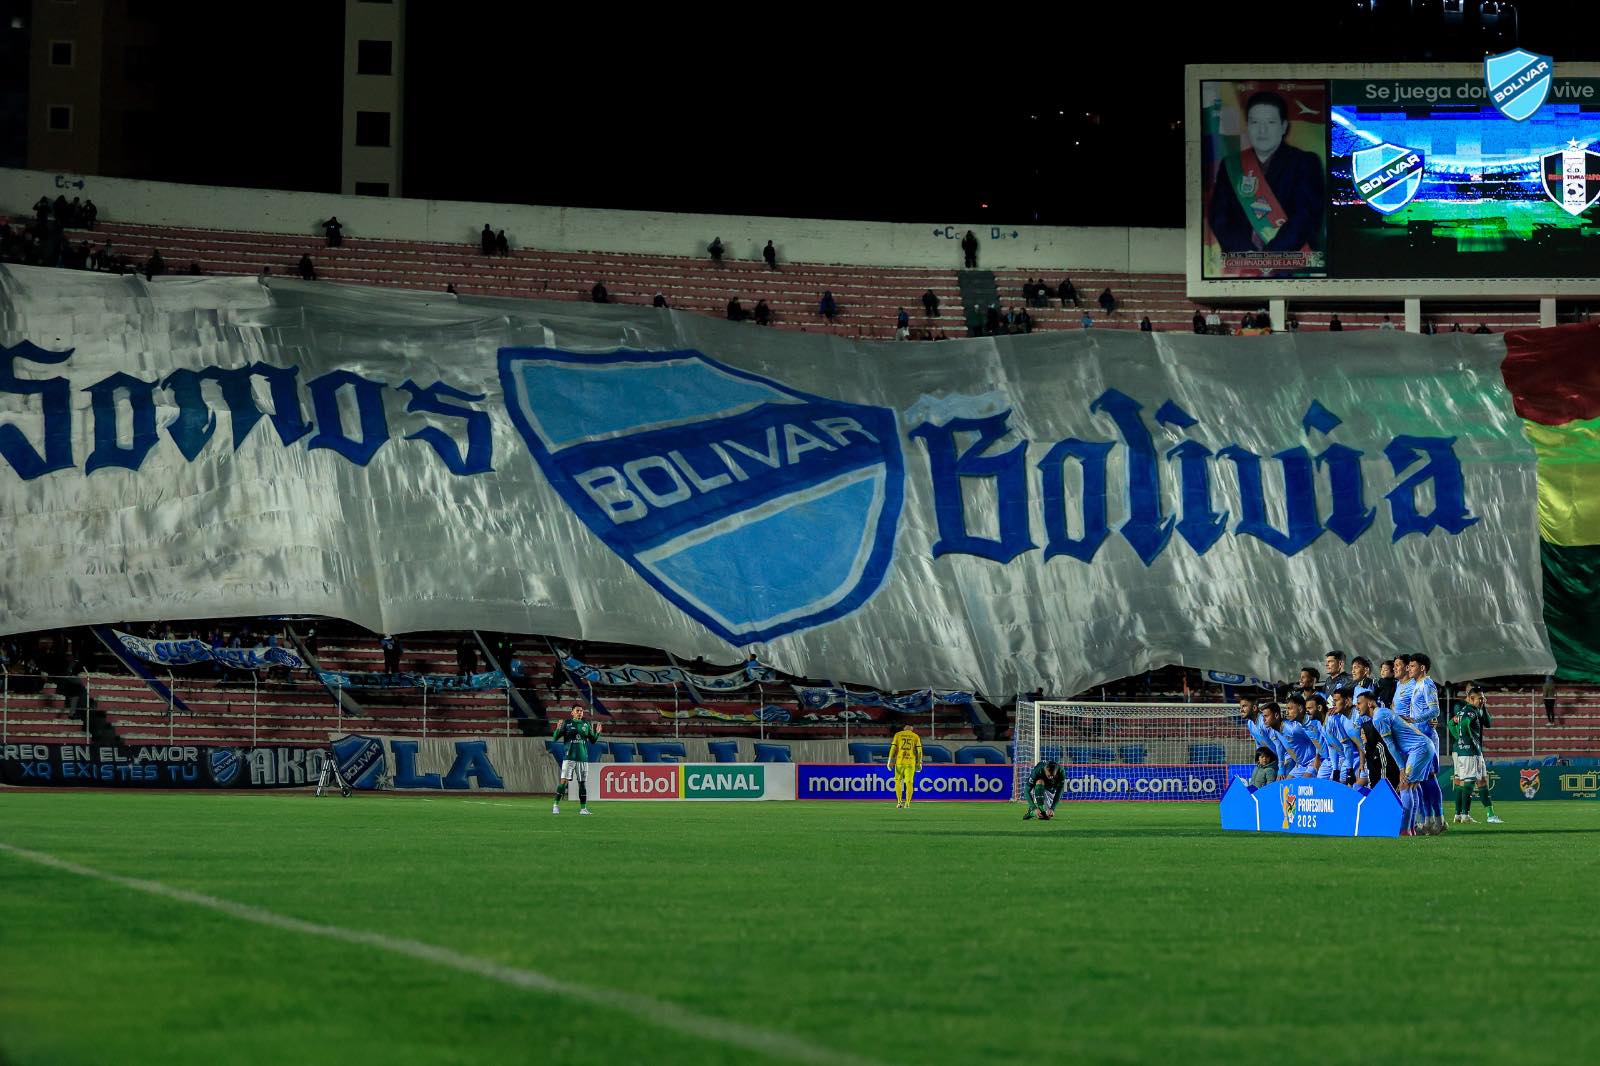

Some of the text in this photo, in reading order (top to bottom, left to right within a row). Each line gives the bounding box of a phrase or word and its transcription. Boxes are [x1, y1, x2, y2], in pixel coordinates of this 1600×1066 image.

[1365, 83, 1389, 99] Se
[1393, 83, 1451, 102] juega
[1553, 81, 1594, 98] vive
[1360, 153, 1420, 195] BOLIVAR
[0, 339, 496, 480] Somos
[573, 416, 880, 525] BOLIVAR
[908, 387, 1481, 567] Bolivia
[60, 745, 91, 761] EN
[100, 746, 128, 762] EL
[138, 746, 198, 762] AMOR
[902, 738, 911, 750] 25
[62, 762, 158, 781] EXISTES
[167, 763, 198, 781] TÚ
[214, 755, 236, 773] BOLIVAR
[342, 742, 381, 781] BOLIVAR
[390, 740, 504, 789] LA
[604, 771, 676, 793] fútbol
[687, 773, 760, 791] CANAL
[1064, 774, 1216, 793] rathoncom.bo
[1298, 798, 1334, 812] PROFESIONAL
[1297, 815, 1316, 828] 2025
